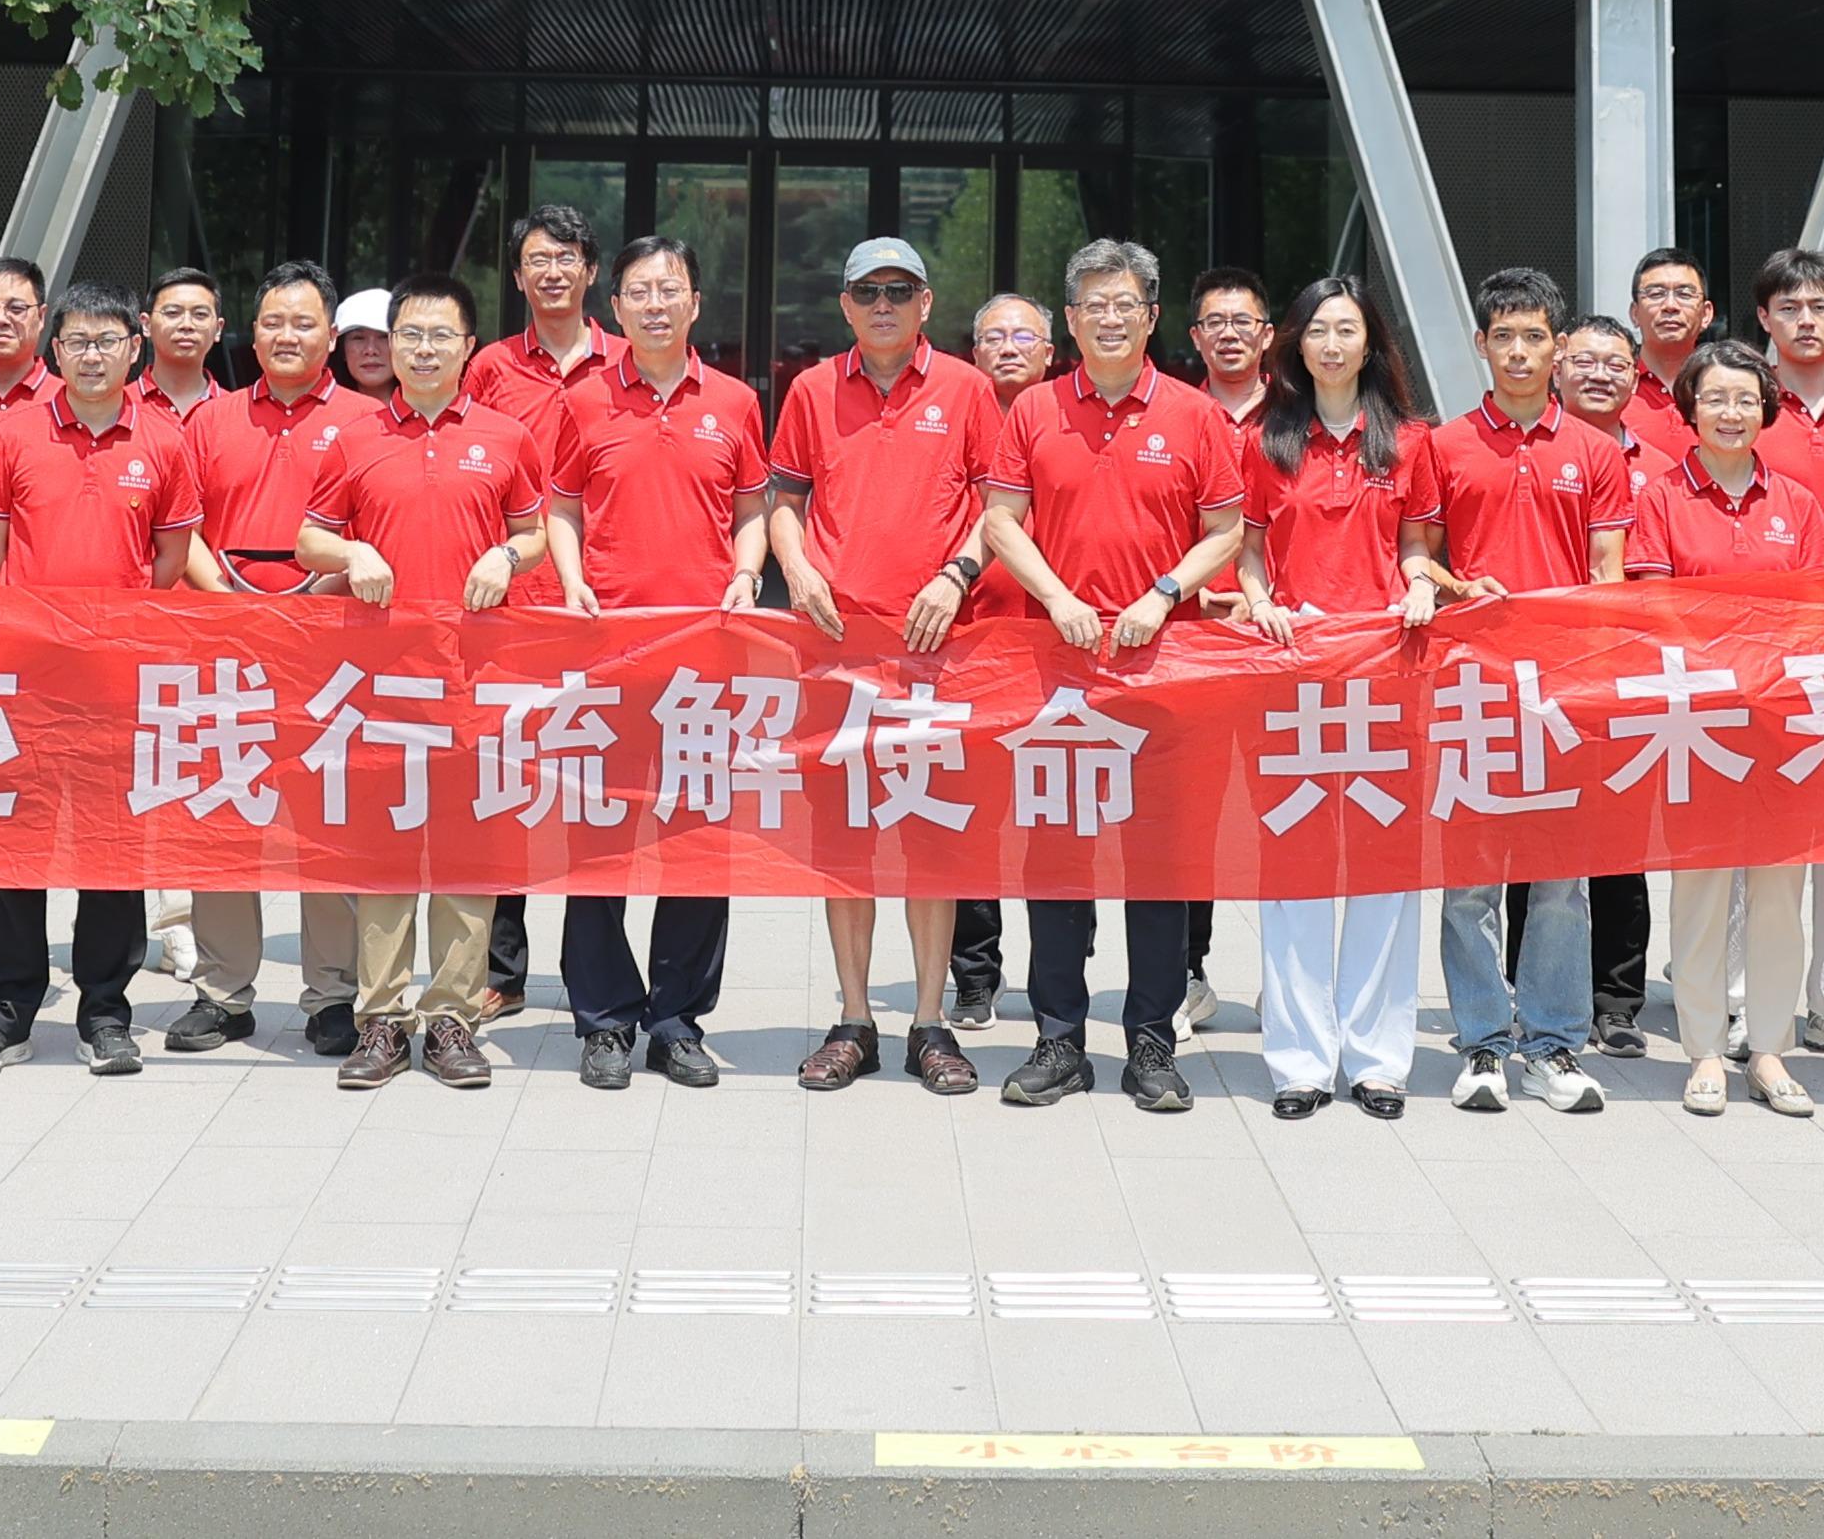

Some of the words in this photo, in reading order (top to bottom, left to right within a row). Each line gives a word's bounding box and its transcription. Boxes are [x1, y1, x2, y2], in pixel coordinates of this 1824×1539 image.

[127, 657, 1149, 837] 践行疏解使命
[955, 1440, 1340, 1463] 小心台阶
